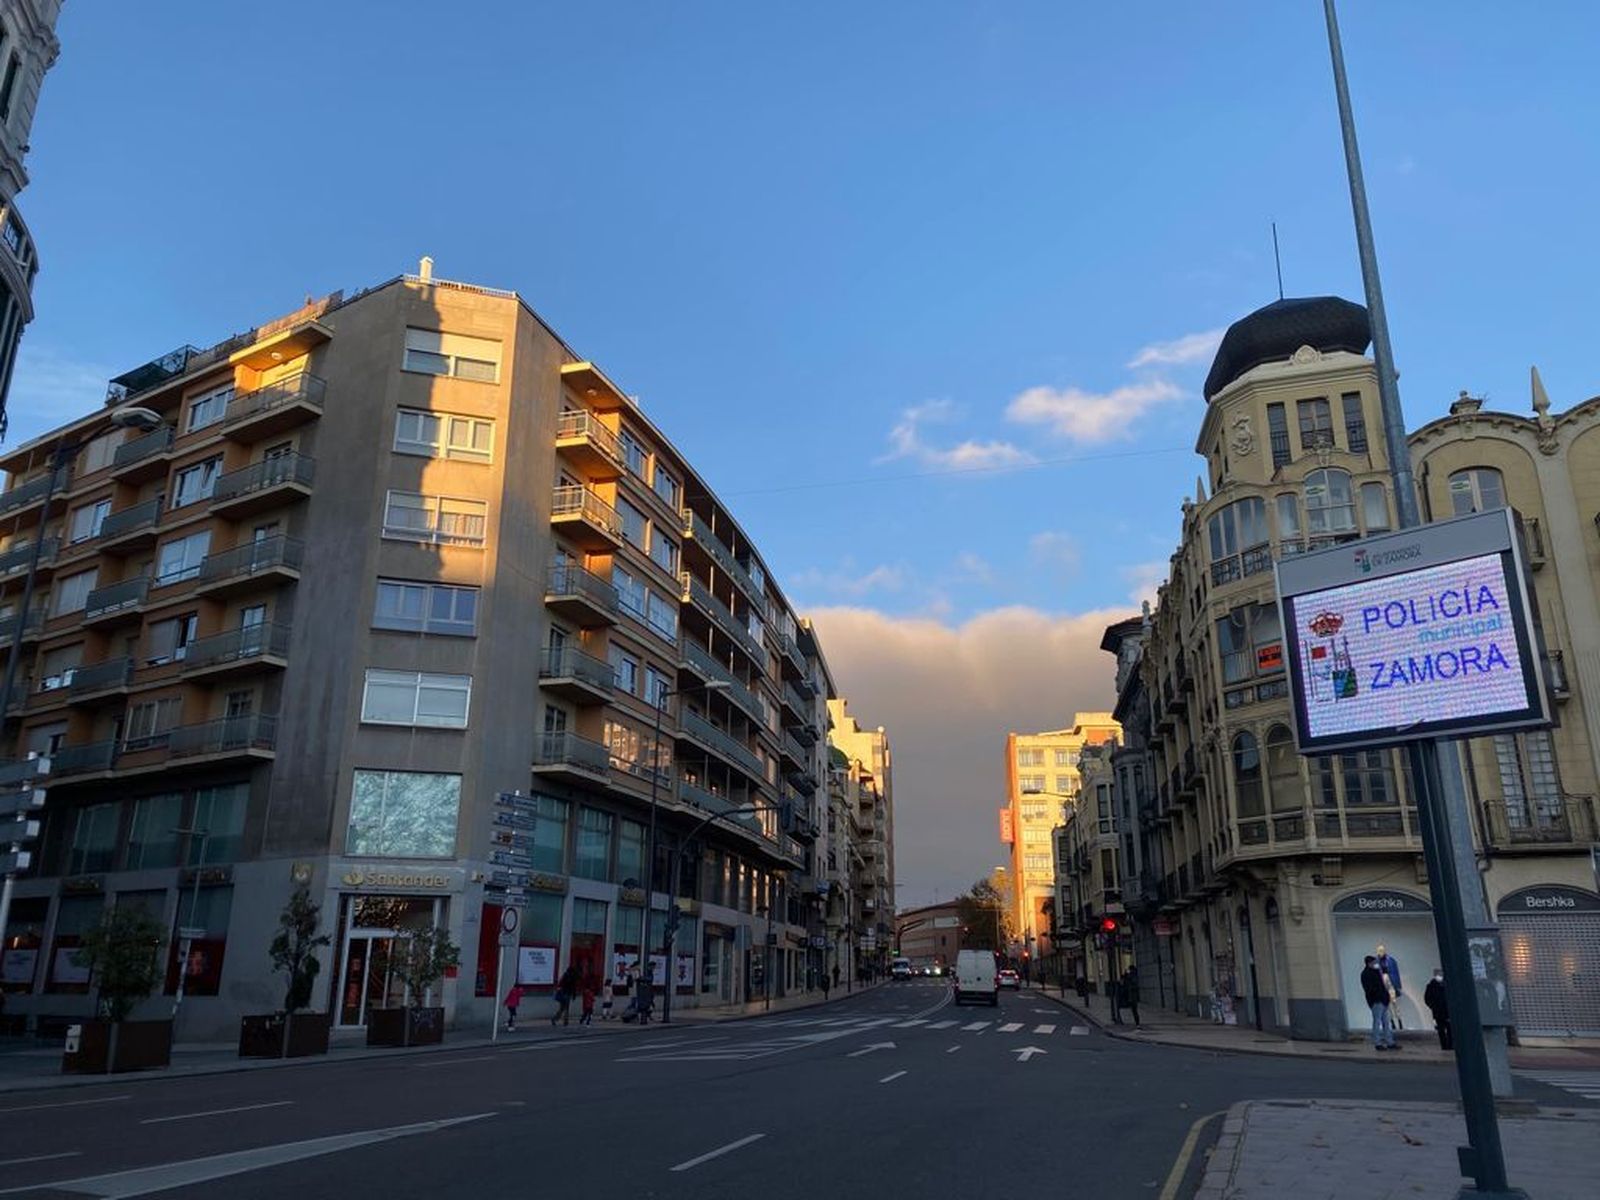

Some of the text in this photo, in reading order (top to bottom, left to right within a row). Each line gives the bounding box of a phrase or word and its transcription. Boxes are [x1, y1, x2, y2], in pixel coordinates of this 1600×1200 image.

[1362, 581, 1499, 633] POLICÍA
[1418, 612, 1501, 641] municipal
[1369, 643, 1510, 690] ZAMORA
[366, 872, 450, 888] Santander
[1358, 897, 1404, 909] Bershka
[1525, 896, 1576, 908] Bershka
